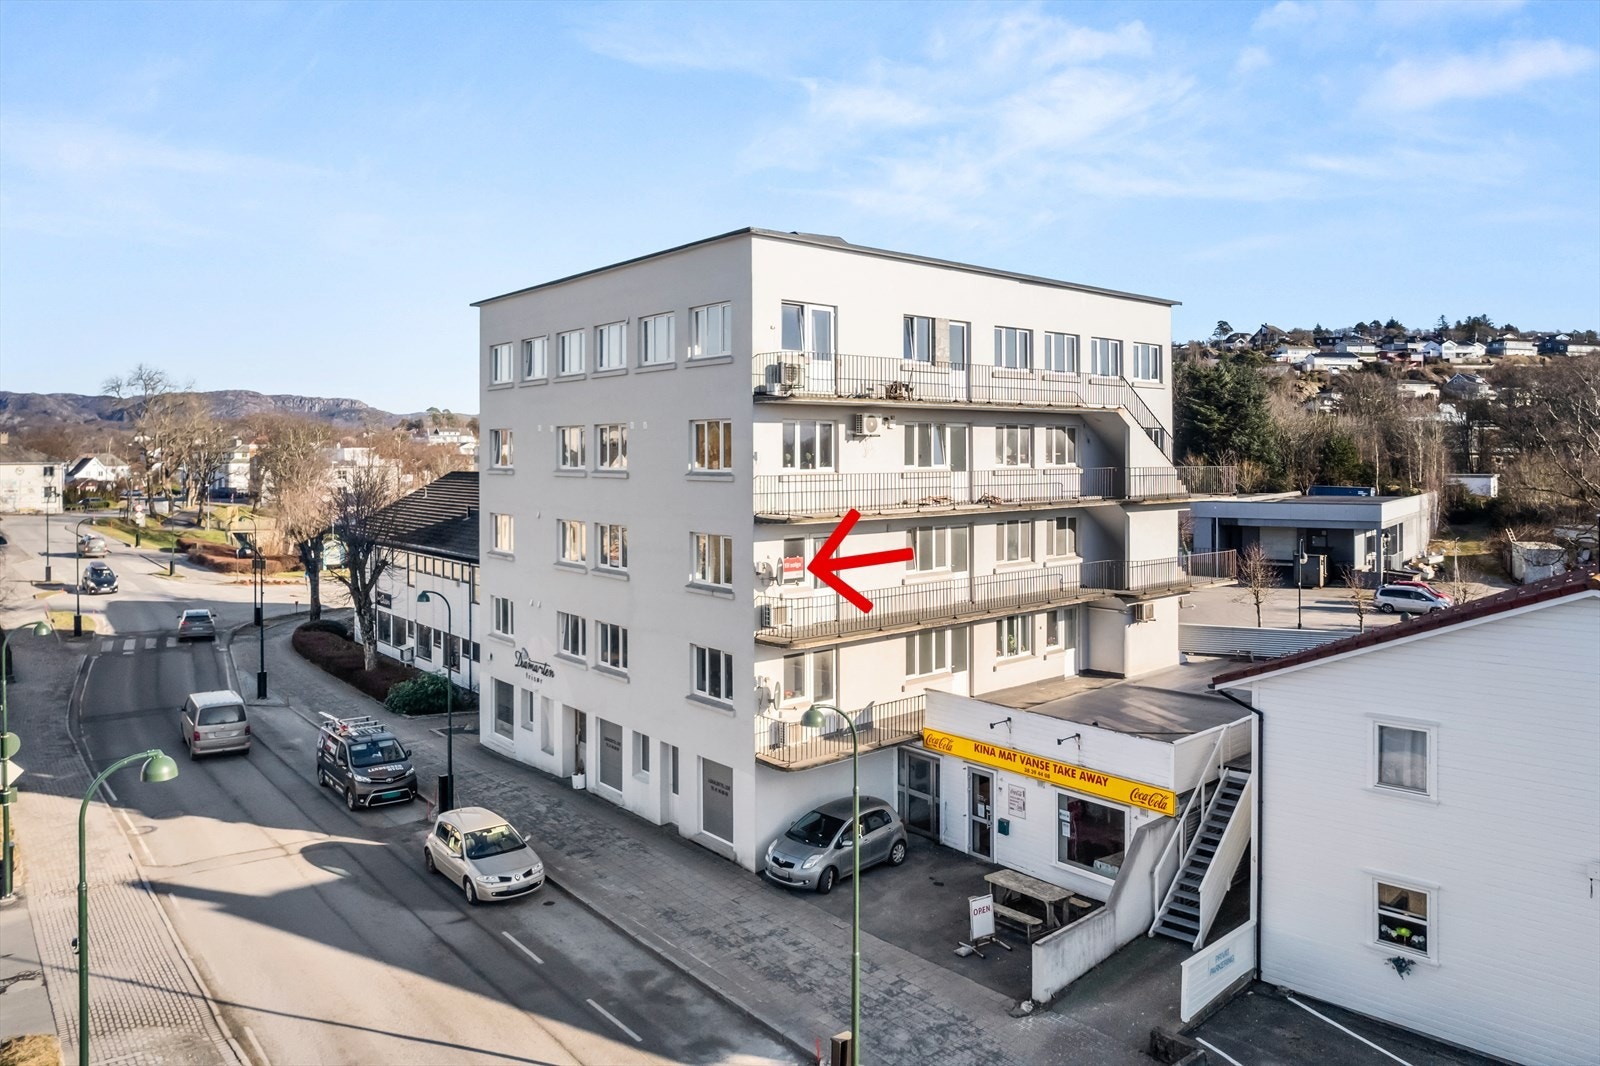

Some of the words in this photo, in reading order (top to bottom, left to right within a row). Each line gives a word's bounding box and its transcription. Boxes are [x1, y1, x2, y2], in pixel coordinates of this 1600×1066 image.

[925, 733, 954, 752] Coca-Cola
[974, 743, 996, 757] KINA
[998, 749, 1017, 763] MAT
[1019, 755, 1050, 771] VANSE
[1052, 763, 1076, 779] TAKE
[1079, 771, 1109, 787] AWAY
[1129, 787, 1169, 810] Coca-Cola
[973, 904, 991, 916] OPEN
